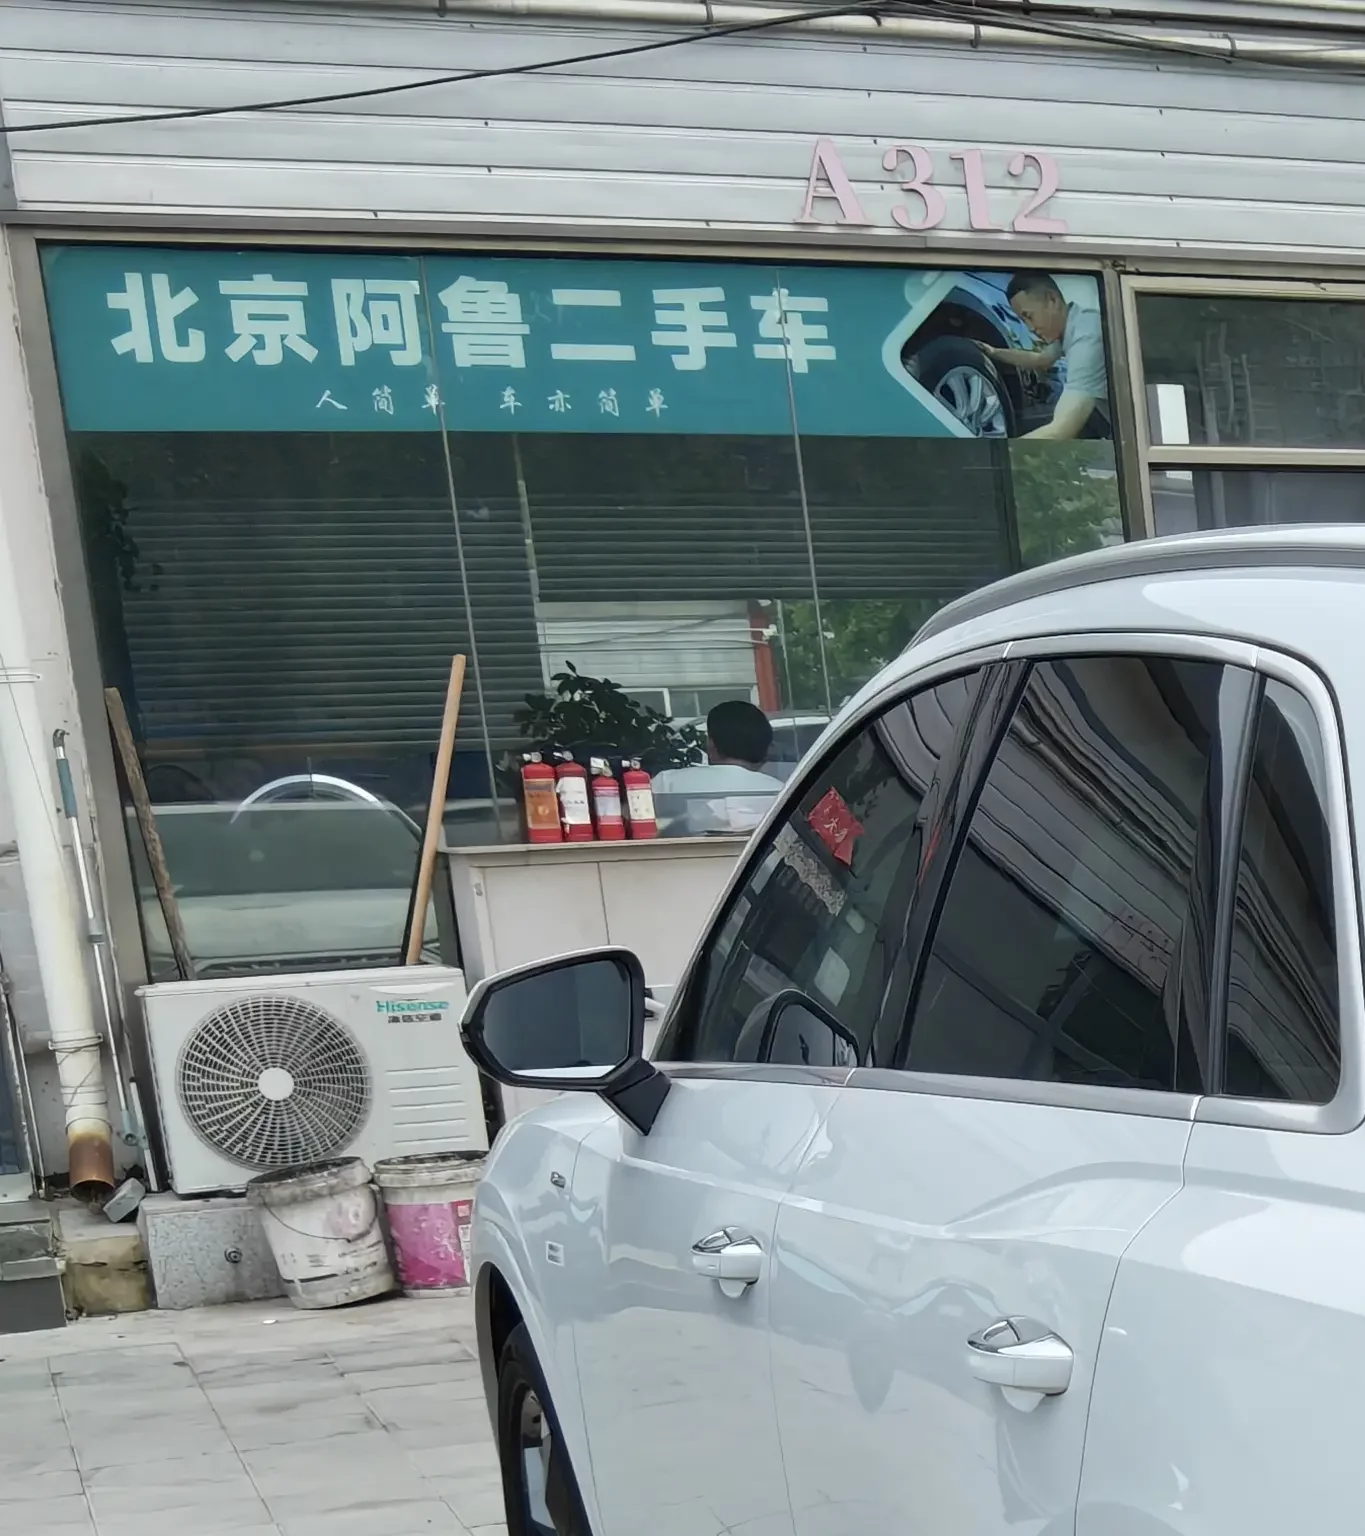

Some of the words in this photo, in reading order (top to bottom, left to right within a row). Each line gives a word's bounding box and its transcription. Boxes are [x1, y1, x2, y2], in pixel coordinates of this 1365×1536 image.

[793, 138, 1068, 234] A312
[105, 272, 837, 373] 北京阿鲁二手车
